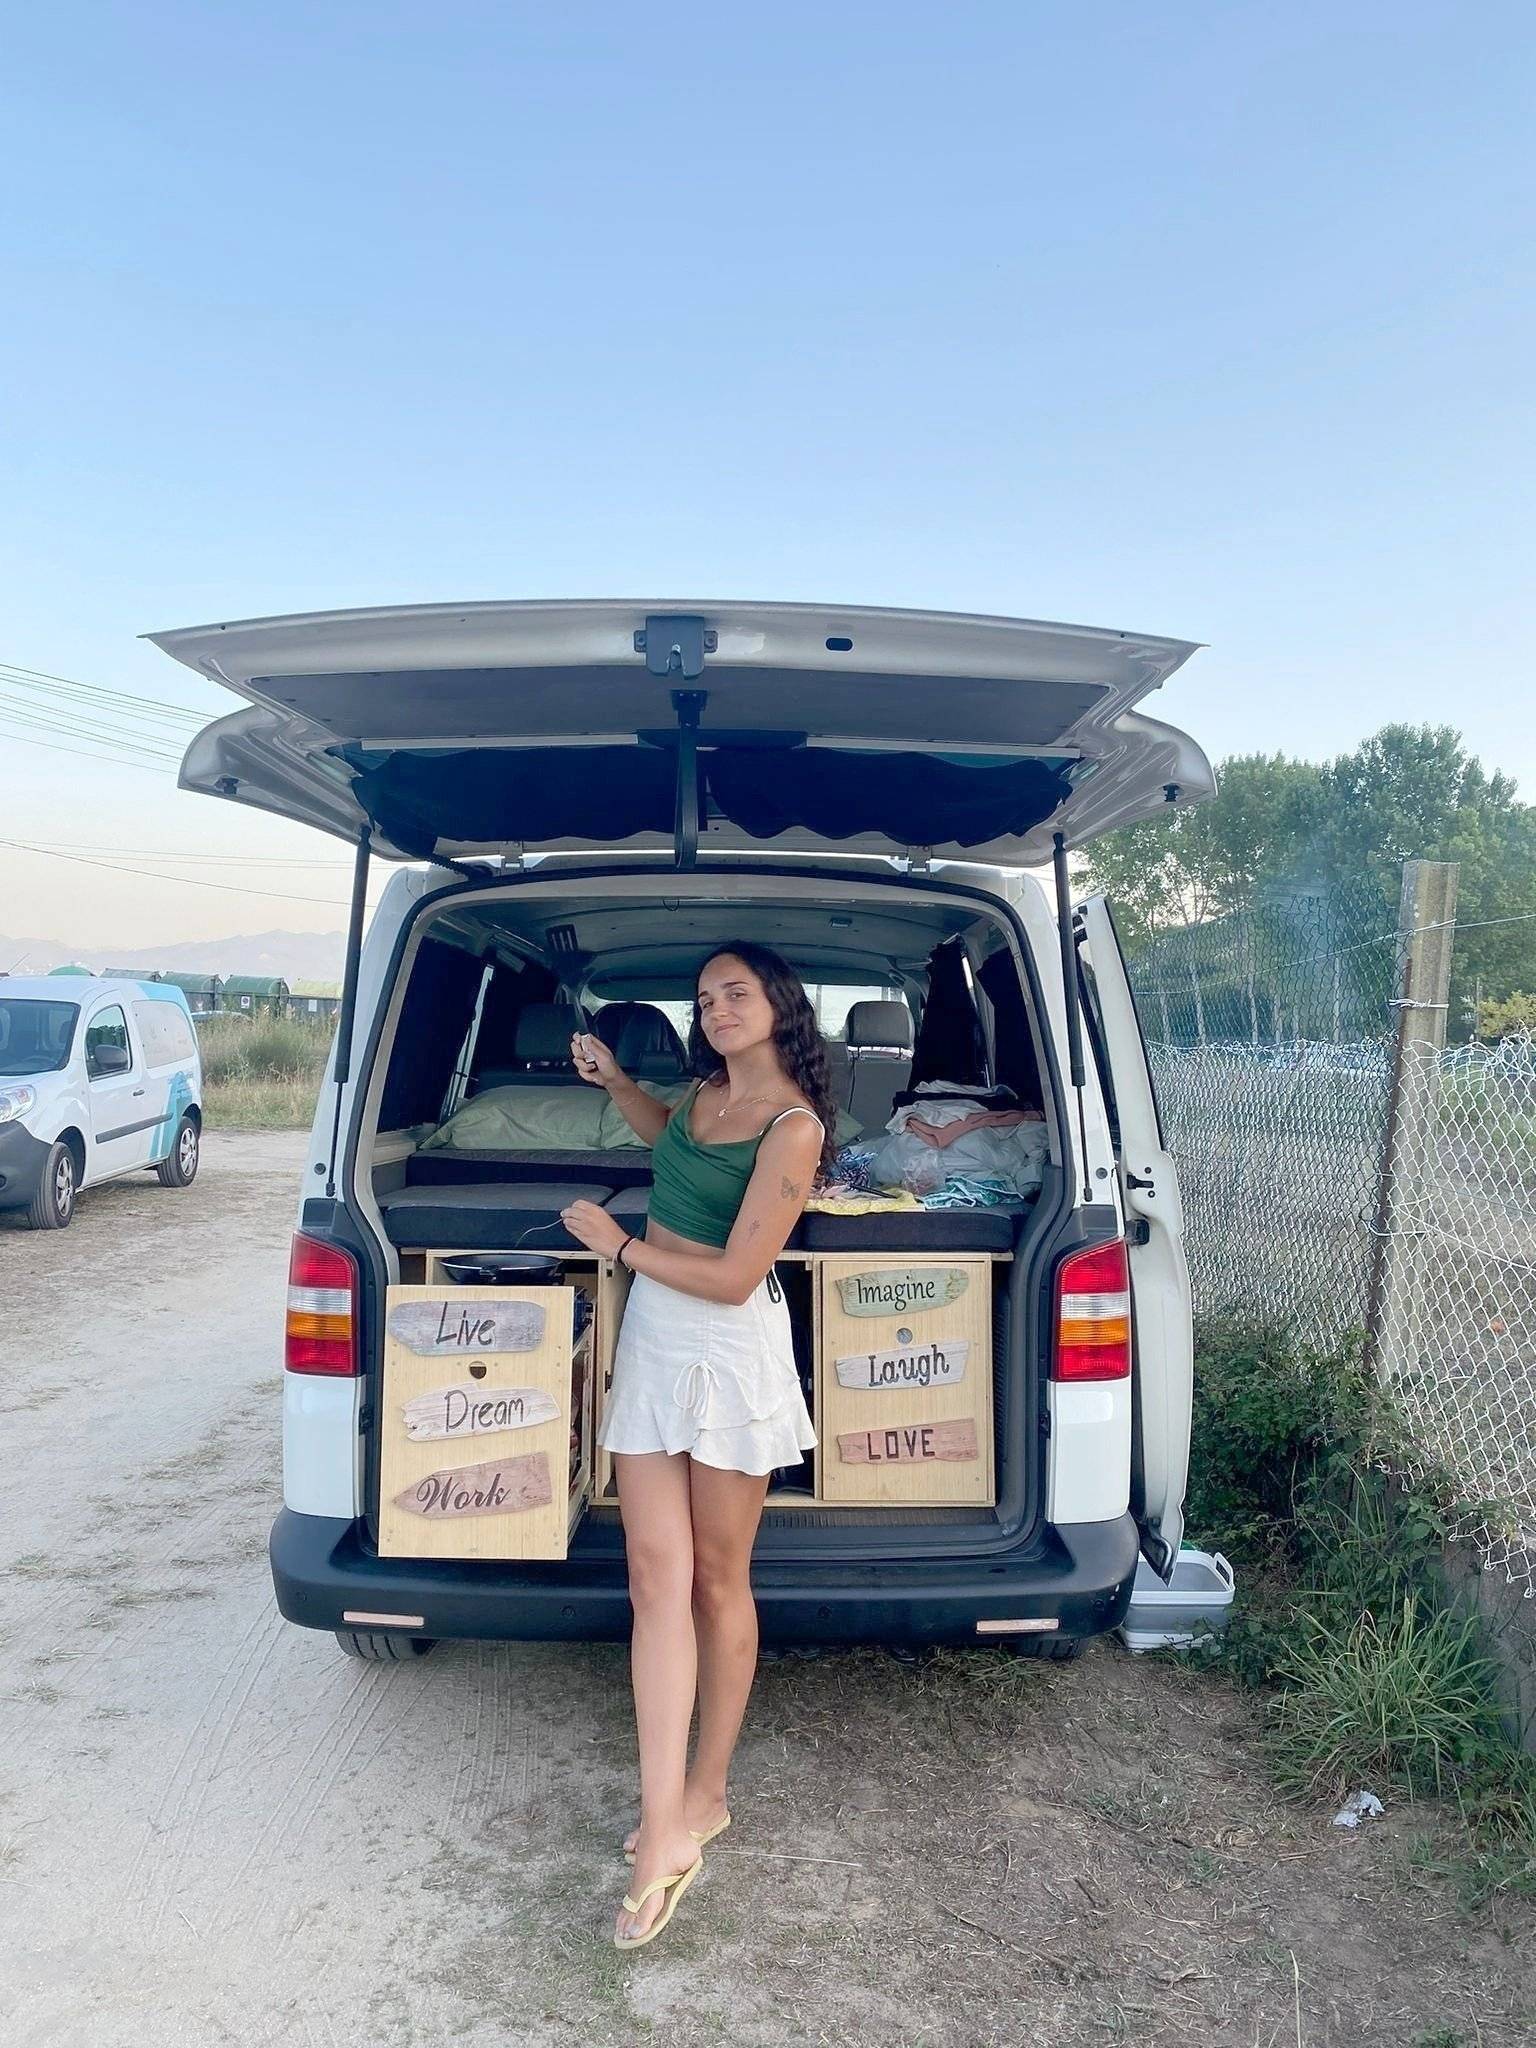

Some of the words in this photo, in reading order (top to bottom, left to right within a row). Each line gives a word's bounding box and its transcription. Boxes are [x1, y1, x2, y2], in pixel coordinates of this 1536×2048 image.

[855, 1275, 936, 1311] Imagine
[435, 1302, 496, 1346] Live
[868, 1344, 950, 1387] Laugh
[444, 1389, 524, 1432] Dream
[867, 1429, 936, 1460] LOVE
[416, 1473, 511, 1514] Work
